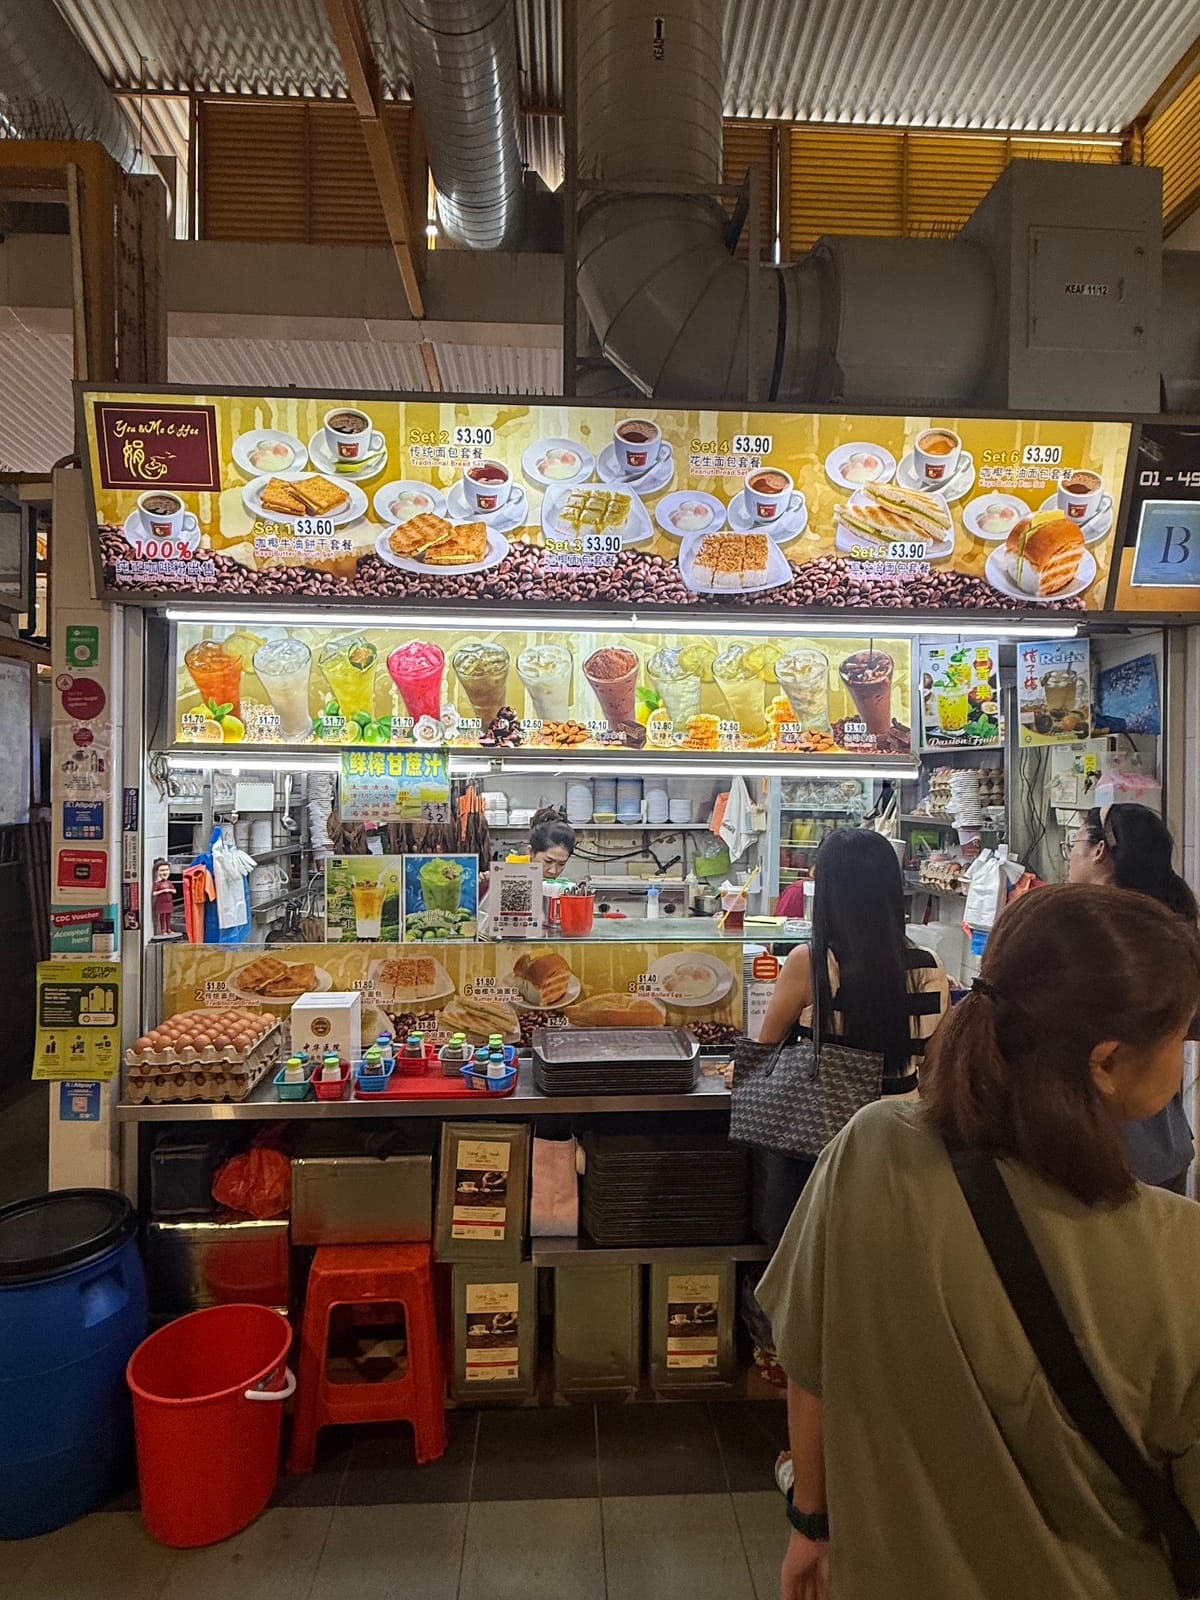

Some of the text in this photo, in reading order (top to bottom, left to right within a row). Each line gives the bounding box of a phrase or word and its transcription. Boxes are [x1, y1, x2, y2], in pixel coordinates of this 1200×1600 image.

[1065, 284, 1086, 294] KEAF
[410, 427, 492, 445] Set 2 $3.90
[690, 436, 770, 454] Set 4 $3.90
[410, 446, 484, 460] 传统面包套餐
[982, 447, 1060, 463] Set 6 $3.90
[412, 459, 449, 467] Traditional
[690, 455, 761, 468] 花生面包套餐
[254, 519, 332, 535] Set 1 $3.60
[545, 536, 620, 552] Set 3 $3.90
[1160, 526, 1192, 564] B
[135, 540, 193, 560] 100%
[850, 543, 925, 559] Set 5 $3.90
[1039, 651, 1086, 665] Relax
[183, 714, 205, 723] $1.70
[259, 716, 280, 725] $1.70
[324, 717, 346, 726] $1.70
[392, 717, 413, 727] $1.70
[460, 719, 480, 729] $1.70
[522, 719, 542, 729] $2.60
[587, 720, 607, 730] $2.10
[719, 722, 739, 731] $2.60
[781, 723, 801, 732] $3.10
[846, 723, 866, 732] $3.10
[927, 735, 997, 746] Passion Fruit
[348, 751, 442, 777] 鲜榨甘蔗汁
[55, 911, 100, 922] CDC Voucher
[54, 927, 90, 938] Accepted
[638, 974, 657, 983] $1.40
[464, 984, 474, 996] 6
[628, 981, 638, 993] 8
[194, 985, 204, 1001] 2
